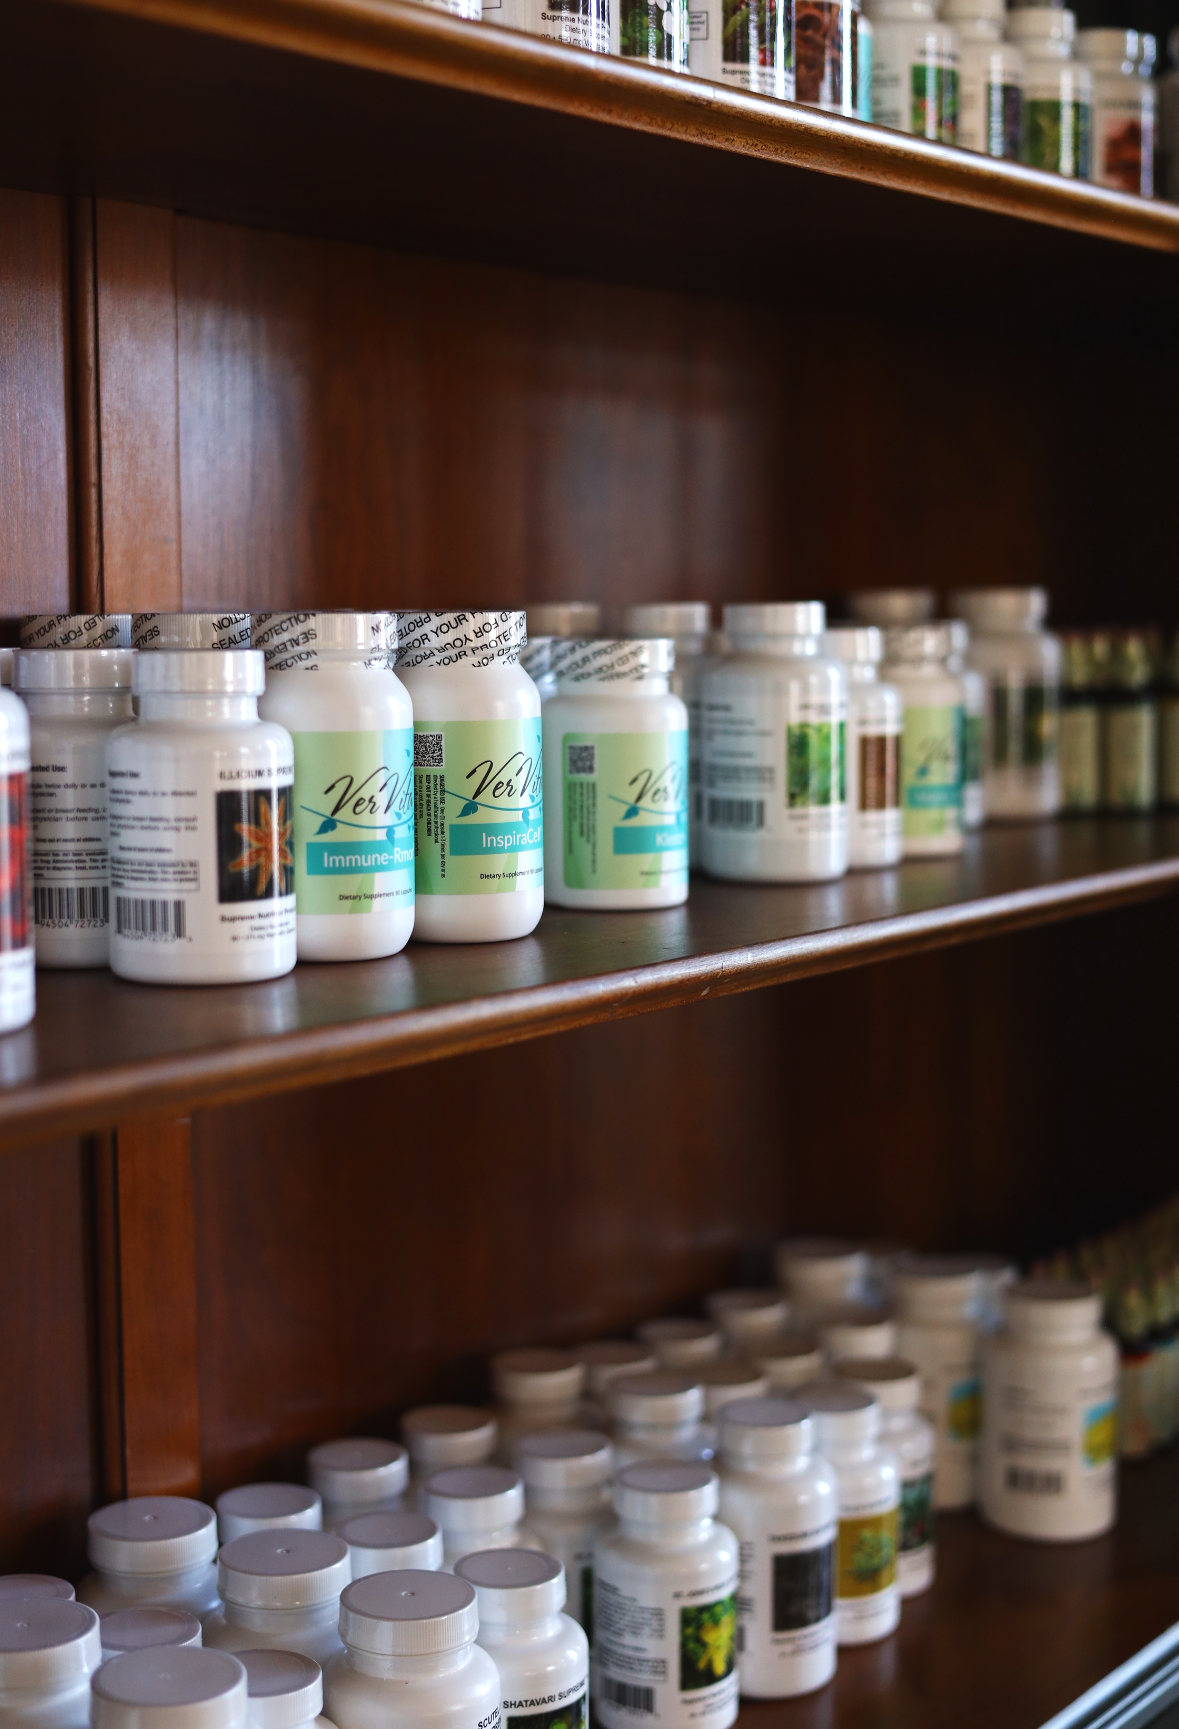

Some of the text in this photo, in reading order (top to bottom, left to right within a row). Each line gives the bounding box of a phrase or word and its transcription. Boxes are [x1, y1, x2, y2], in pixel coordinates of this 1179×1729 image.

[541, 12, 576, 23] Supreme
[34, 619, 57, 640] YOUR
[59, 626, 84, 645] FOR
[405, 633, 431, 652] FOR
[430, 613, 469, 638] YOUR
[472, 618, 500, 638] FOR
[273, 628, 318, 655] SEALED
[435, 634, 474, 654] YOUR
[435, 650, 469, 667] YOUR
[479, 872, 502, 881] Dietary
[338, 893, 363, 902] Dietary
[363, 890, 396, 900] Supplement
[75, 918, 106, 928] 72723
[502, 1694, 557, 1710] SHATAVARI
